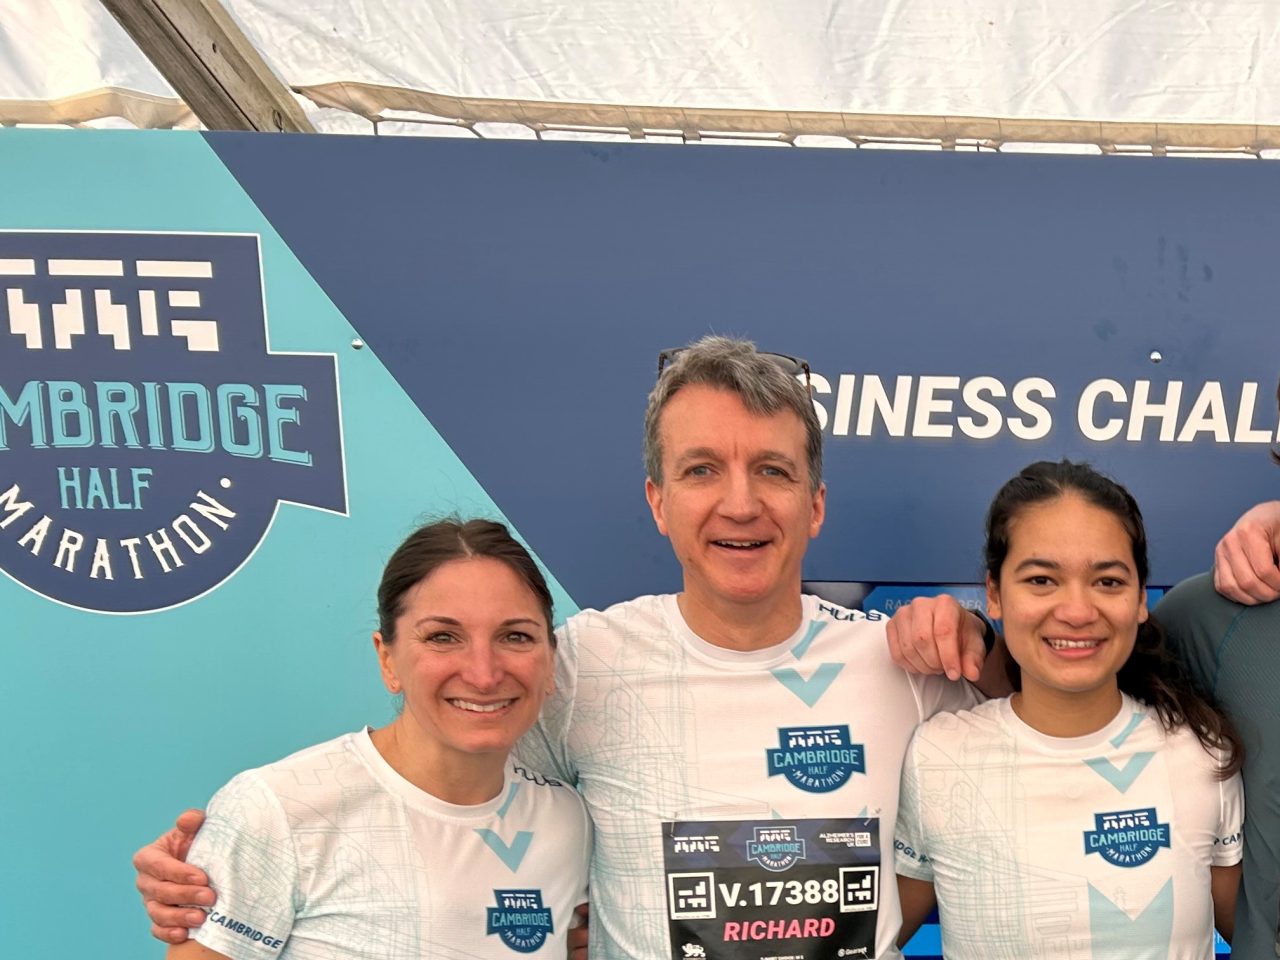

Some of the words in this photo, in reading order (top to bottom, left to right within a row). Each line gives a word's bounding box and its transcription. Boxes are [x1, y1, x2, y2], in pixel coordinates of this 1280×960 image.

[796, 373, 1056, 441] SINESS
[0, 380, 313, 467] MBRIDGE
[57, 467, 153, 510] HALF
[0, 484, 237, 580] MARATHON
[773, 749, 859, 768] CAMBRIDGE
[793, 768, 844, 788] MARATHON
[807, 765, 828, 775] HALF
[1089, 828, 1166, 848] CAMBRIDGE
[1119, 844, 1137, 852] HALF
[751, 842, 801, 855] CAMBRIDGE
[1106, 846, 1153, 863] MARATHON
[718, 879, 840, 908] V.17388
[491, 912, 551, 927] CAMBRIDGE
[723, 917, 836, 942] RICHARD
[210, 911, 284, 949] CAMBRIDGE
[504, 930, 544, 948] MARATHON
